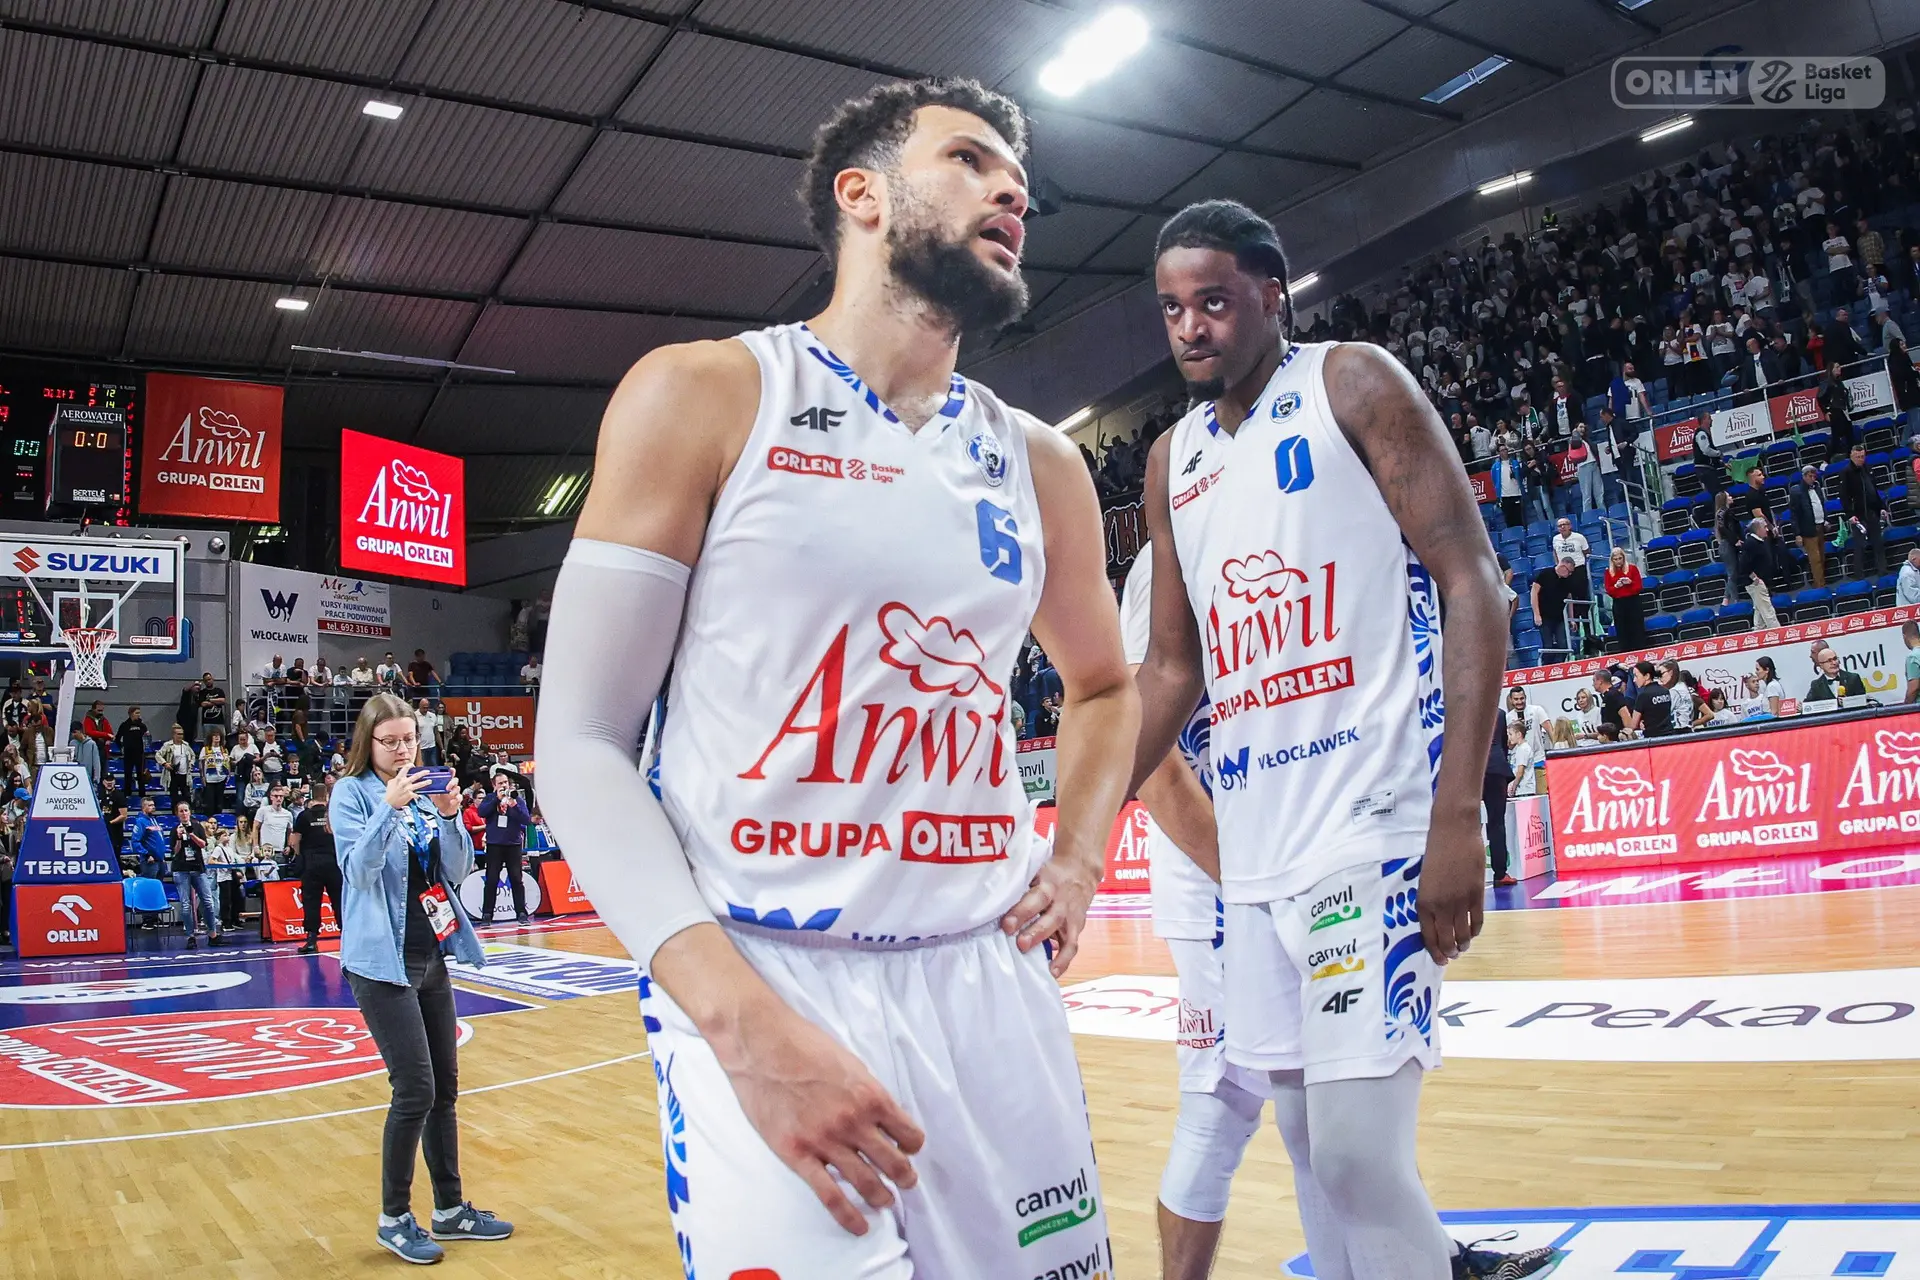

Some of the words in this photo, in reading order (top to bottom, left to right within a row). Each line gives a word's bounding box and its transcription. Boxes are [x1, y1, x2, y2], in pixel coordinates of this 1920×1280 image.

[61, 409, 122, 422] AEROWATCH
[1785, 398, 1816, 418] Anwil
[159, 412, 266, 469] Anwil
[771, 449, 838, 475] ORLEN
[871, 463, 905, 476] Basket
[1274, 434, 1315, 494] 0
[157, 471, 207, 487] GRUPA
[211, 475, 261, 491] ORLEN
[872, 472, 893, 484] Liga
[356, 466, 452, 539] Anwil
[356, 536, 404, 556] GRUPA
[408, 545, 450, 564] ORLEN
[975, 498, 1022, 585] 6
[47, 552, 159, 575] SUZUKI
[320, 600, 342, 610] KURSY
[343, 603, 387, 615] NURKOWANIA
[324, 610, 346, 619] PRACE
[347, 612, 384, 624] PODWODNE
[250, 629, 308, 644] WŁOCŁAWEK
[326, 622, 338, 631] tel.
[340, 623, 354, 632] 692
[356, 625, 368, 634] 316
[370, 627, 383, 636] 131
[1210, 690, 1261, 727] GRUPA
[1266, 661, 1348, 701] ORLEN
[1017, 760, 1045, 777] anvil
[1695, 761, 1812, 823] Anwil
[1562, 775, 1671, 834] Anwil
[1696, 831, 1752, 849] GRUPA
[1757, 826, 1814, 843] ORLEN
[1838, 816, 1898, 835] GRUPA
[46, 826, 88, 856] TB
[731, 818, 892, 858] GRUPA
[1564, 840, 1618, 859] GRUPA
[1621, 838, 1672, 854] ORLEN
[1115, 868, 1150, 880] GRUPA
[1310, 885, 1353, 918] canvil
[46, 929, 98, 943] ORLEN
[1308, 938, 1357, 967] canvil
[18, 984, 209, 1000] SUZUKI
[1322, 988, 1364, 1014] 4F
[1506, 1001, 1917, 1029] Pekao
[0, 1034, 59, 1064] RUPA
[36, 1059, 162, 1099] ORLEN
[1016, 1168, 1088, 1218] canvil
